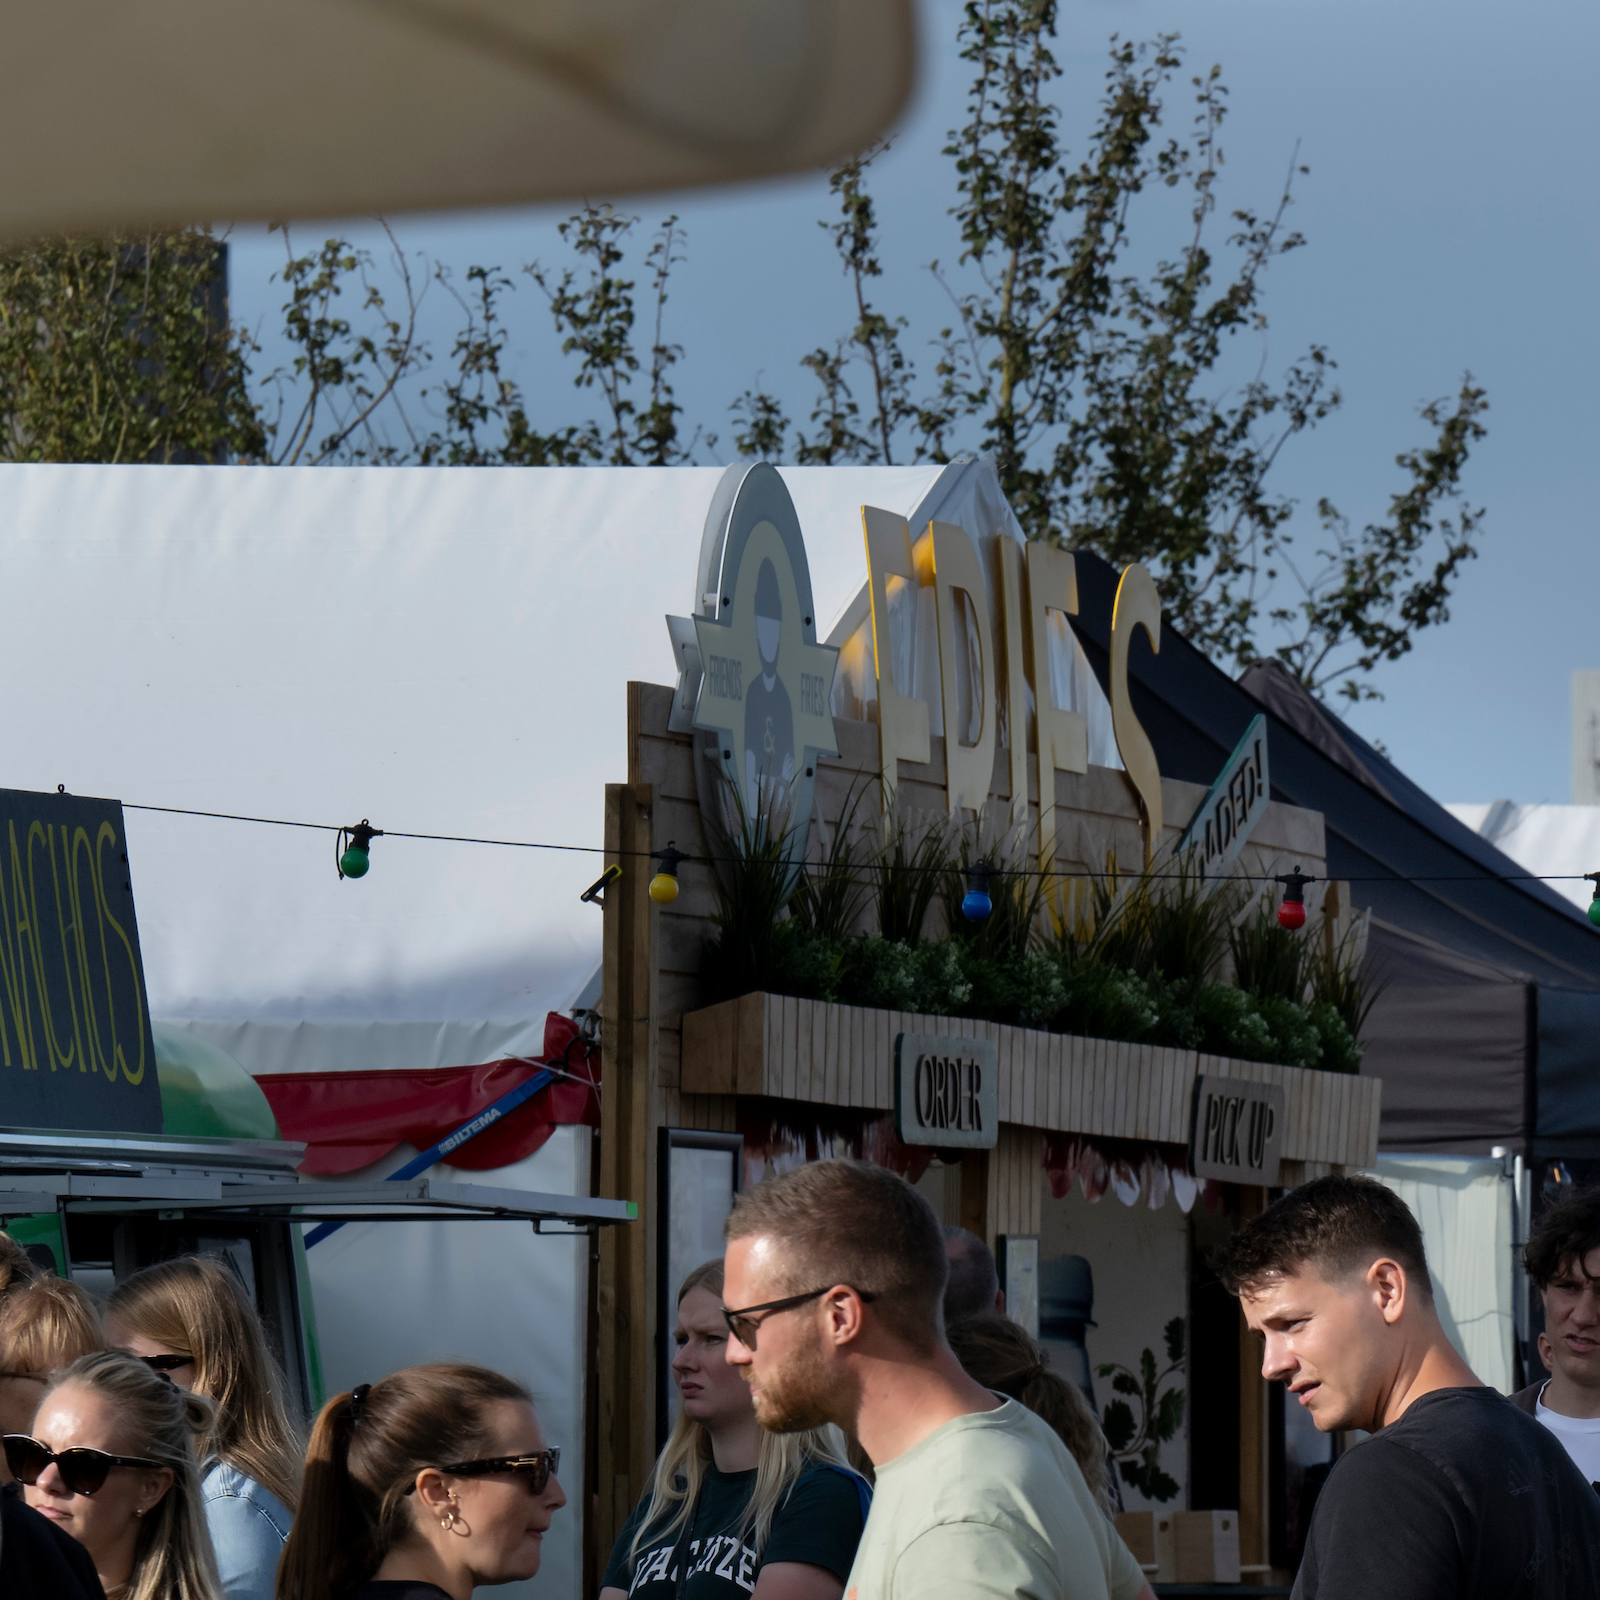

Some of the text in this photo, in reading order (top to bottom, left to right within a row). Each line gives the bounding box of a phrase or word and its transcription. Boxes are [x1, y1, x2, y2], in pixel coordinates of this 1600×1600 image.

[709, 654, 824, 717] FRIENDS FRIES
[914, 1053, 983, 1132] ORDER
[443, 1107, 501, 1152] BILTEMA
[1202, 1093, 1275, 1170] PICK UP
